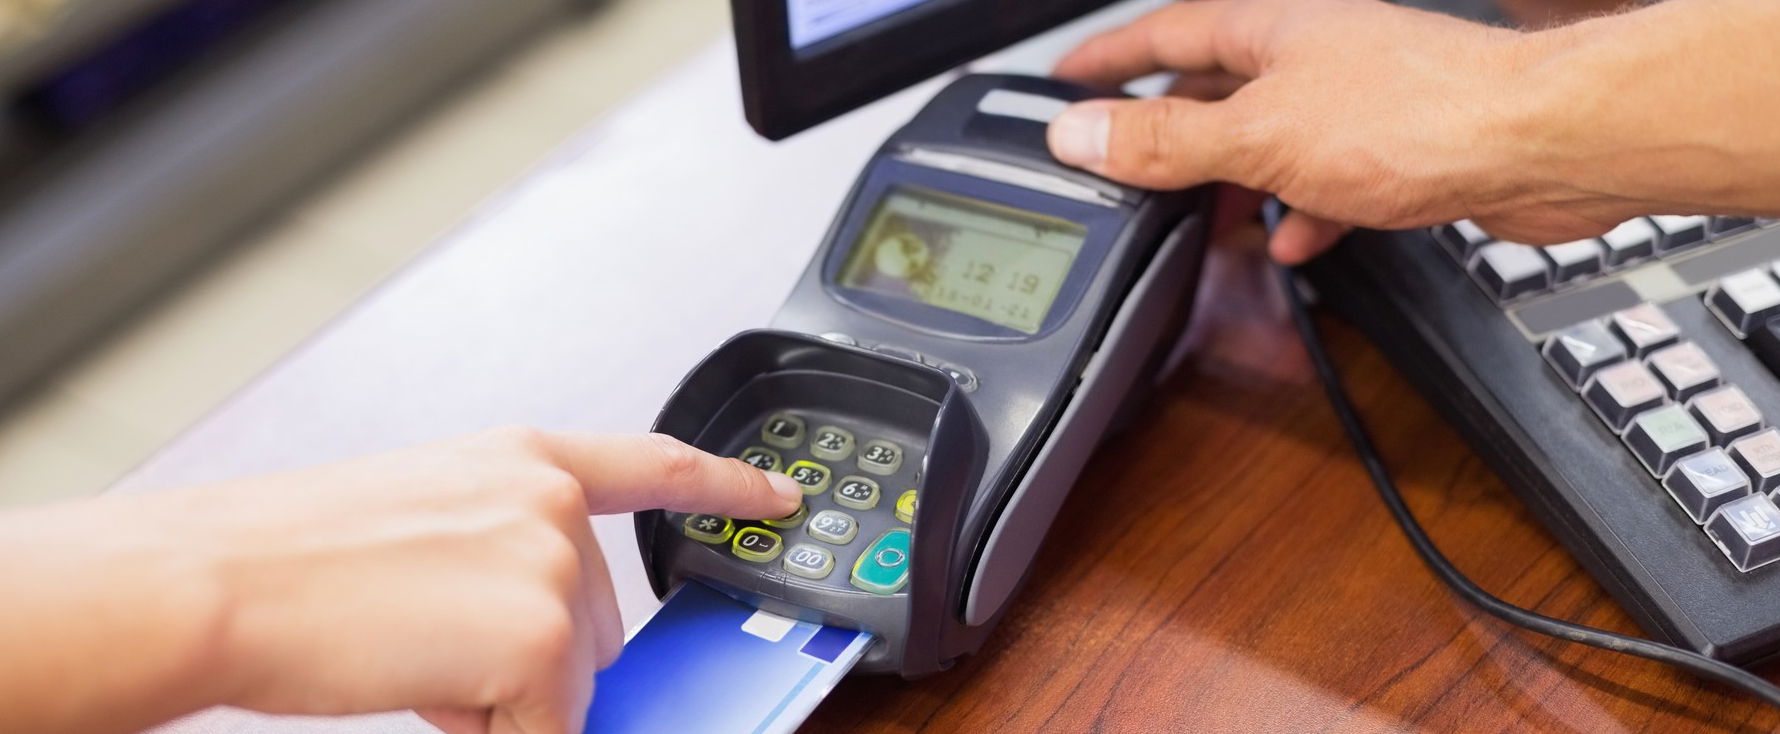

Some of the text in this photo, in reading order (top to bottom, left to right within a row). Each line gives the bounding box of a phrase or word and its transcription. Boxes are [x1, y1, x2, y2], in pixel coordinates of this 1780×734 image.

[962, 259, 1040, 295] 12 19
[772, 421, 786, 434] 1
[818, 433, 835, 447] 2
[866, 446, 883, 460] 3
[793, 467, 811, 481] 5
[842, 483, 858, 495] 6
[818, 517, 833, 528] 9
[743, 535, 759, 546] 0
[796, 551, 822, 565] 00
